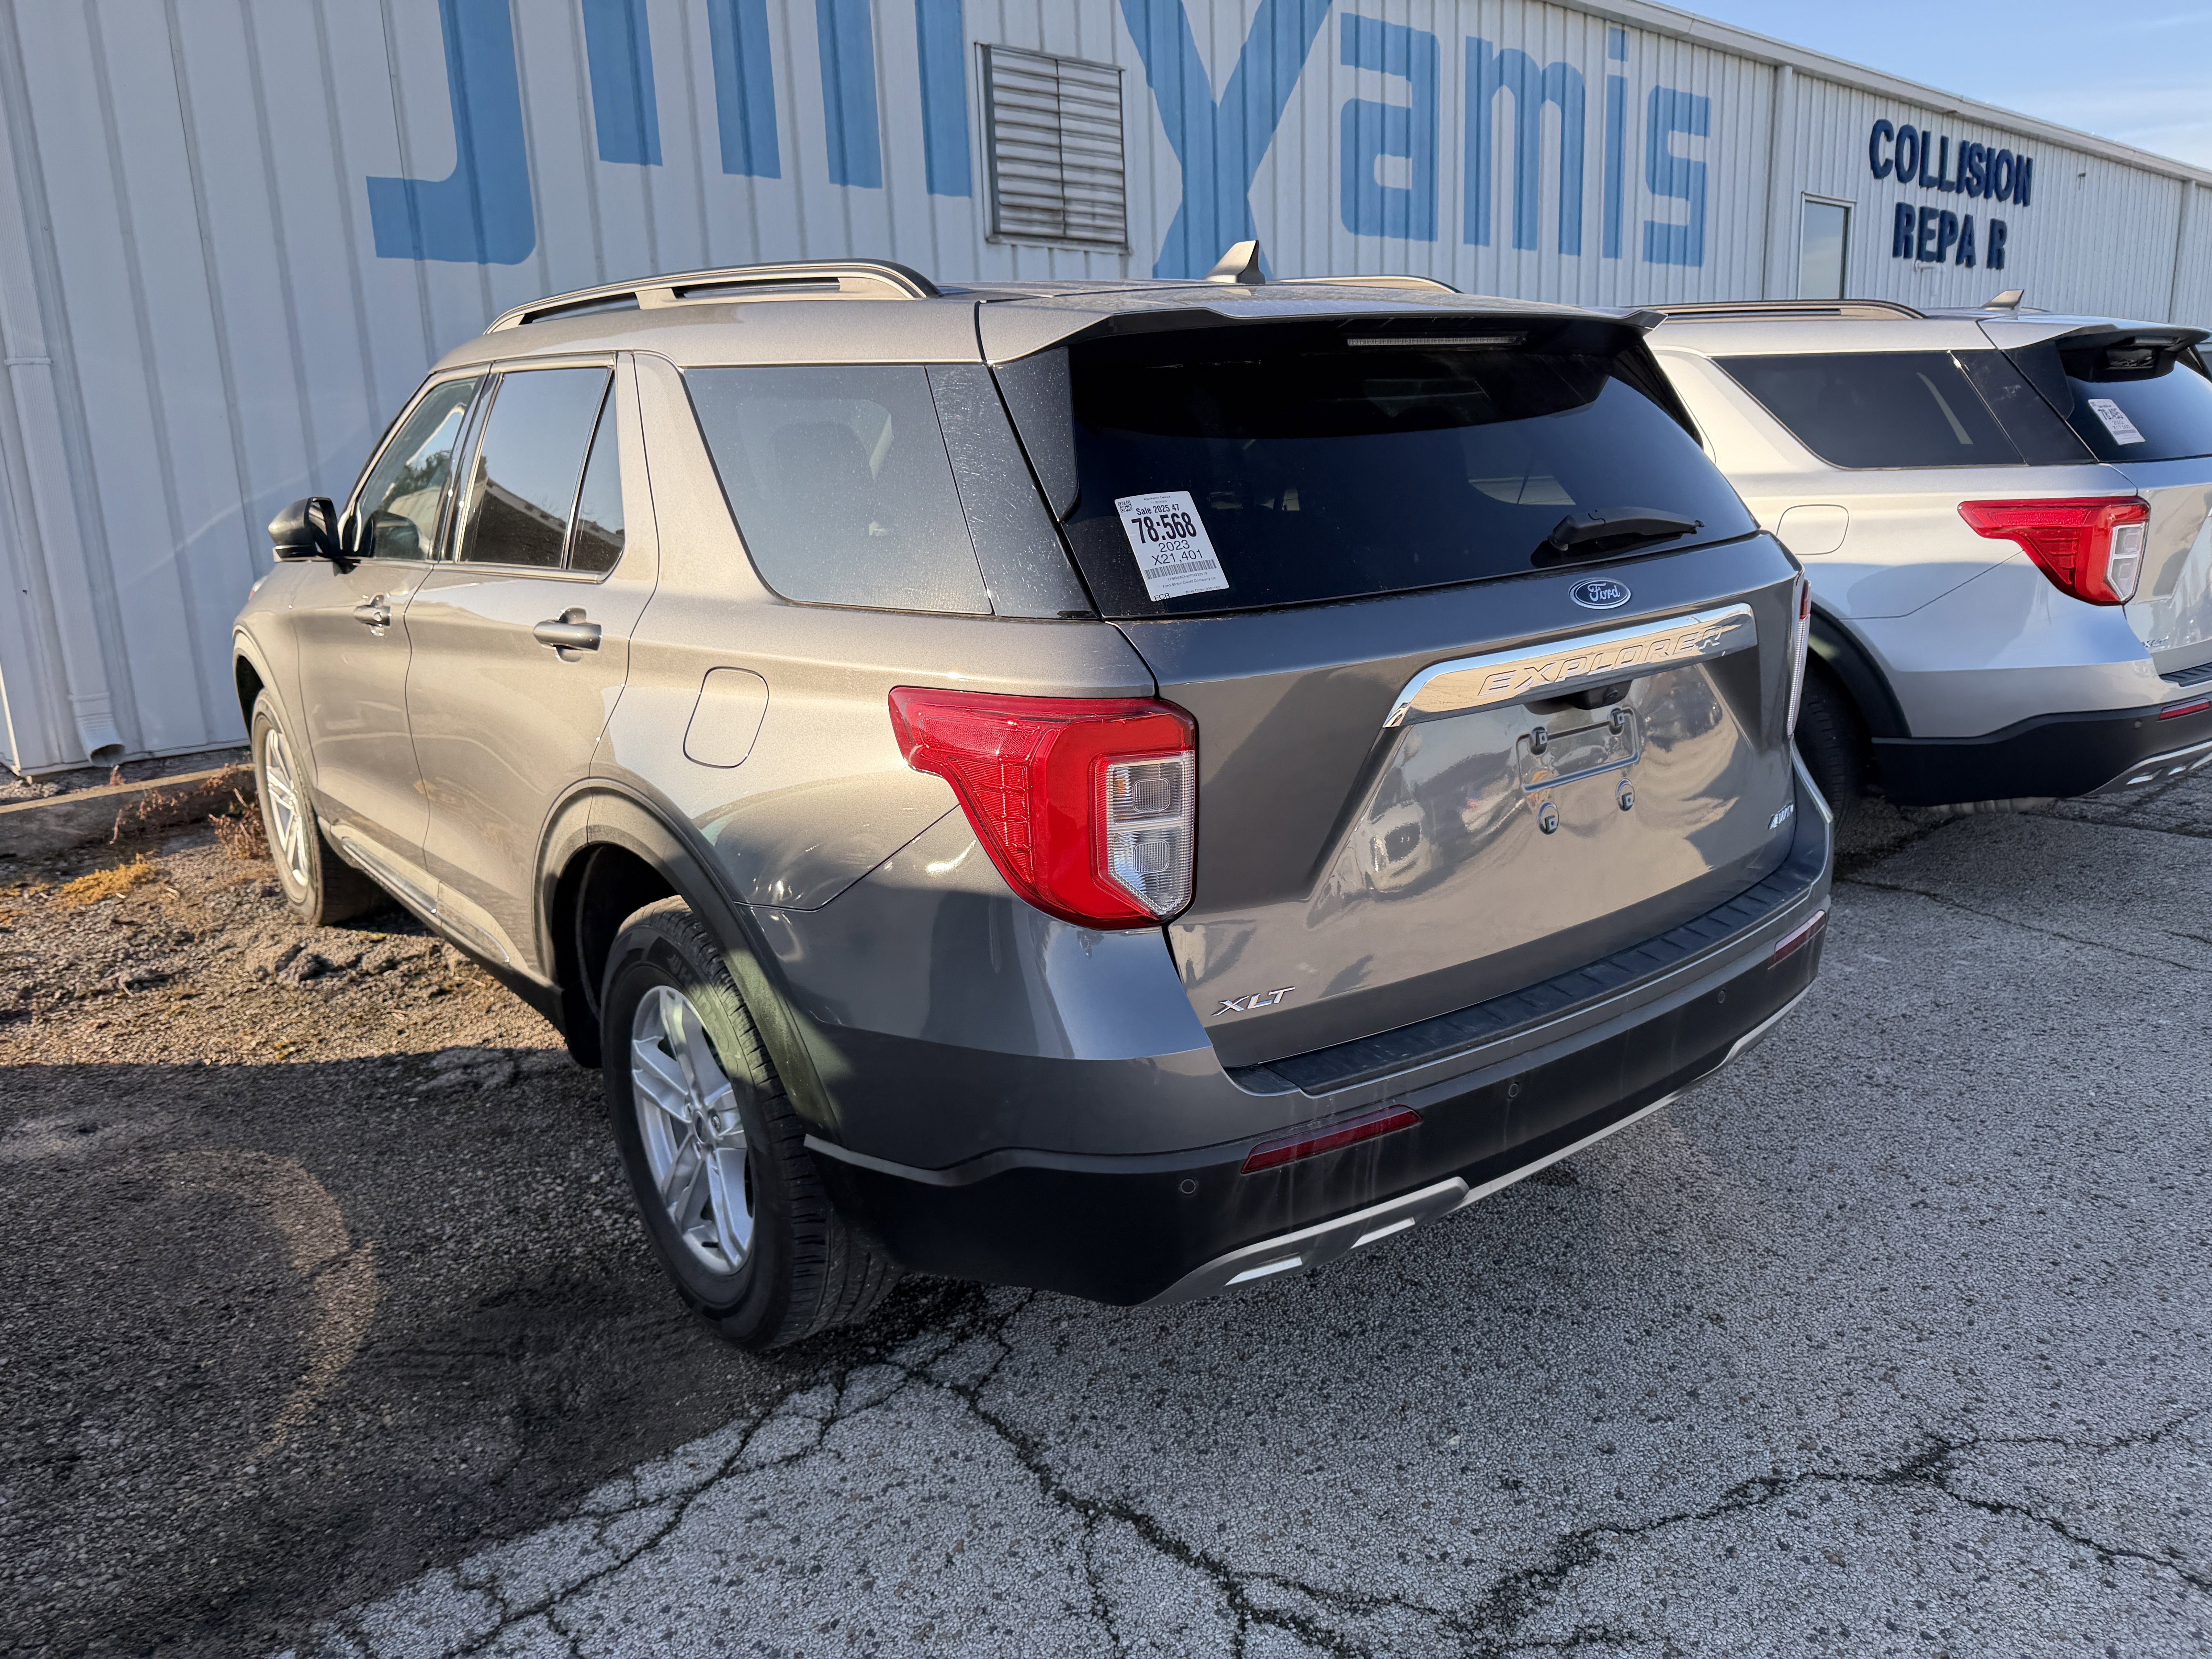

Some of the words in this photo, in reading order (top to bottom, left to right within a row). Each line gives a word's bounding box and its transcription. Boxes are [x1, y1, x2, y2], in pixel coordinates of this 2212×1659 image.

[1119, 0, 1712, 279] Yamis
[1869, 118, 2033, 207] COLLISION
[1136, 507, 1152, 515] Sale
[1153, 505, 1170, 513] 2025
[1131, 512, 1197, 544] 78:568
[1151, 549, 1203, 565] X21,401
[1158, 539, 1190, 553] 2023
[1587, 582, 1620, 602] Ford
[1477, 625, 1723, 697] EXPLORER
[1211, 986, 1295, 1016] XLT
